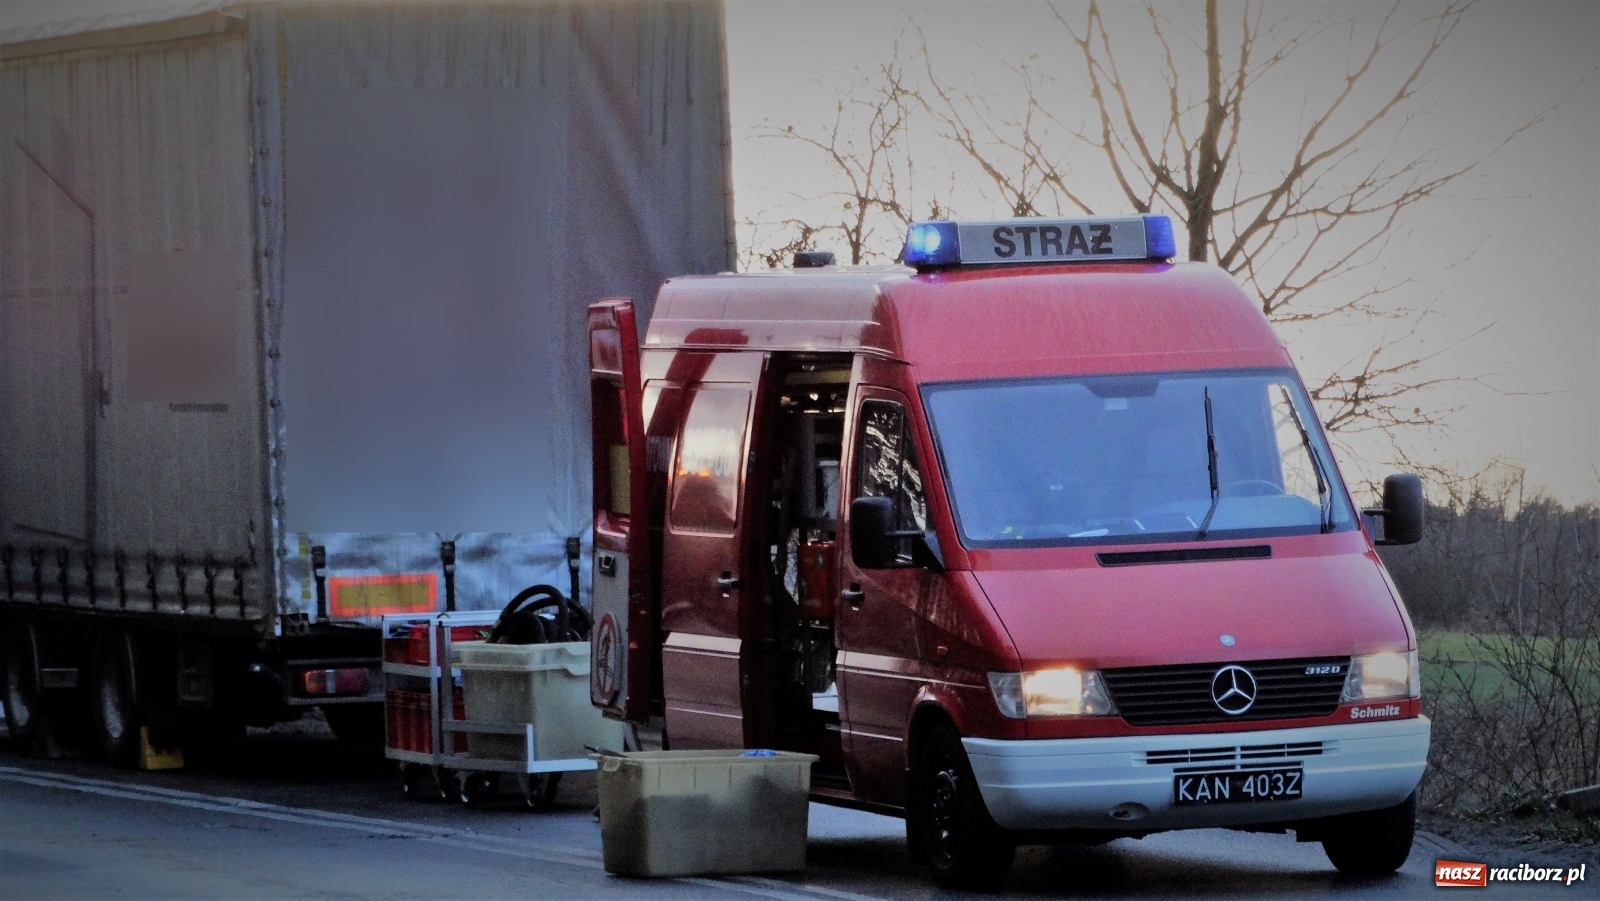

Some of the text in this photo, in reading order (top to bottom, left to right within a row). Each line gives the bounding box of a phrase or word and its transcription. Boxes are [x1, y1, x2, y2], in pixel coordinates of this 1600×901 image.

[1350, 705, 1400, 719] Schmitz
[1179, 772, 1301, 800] KAN 403Z
